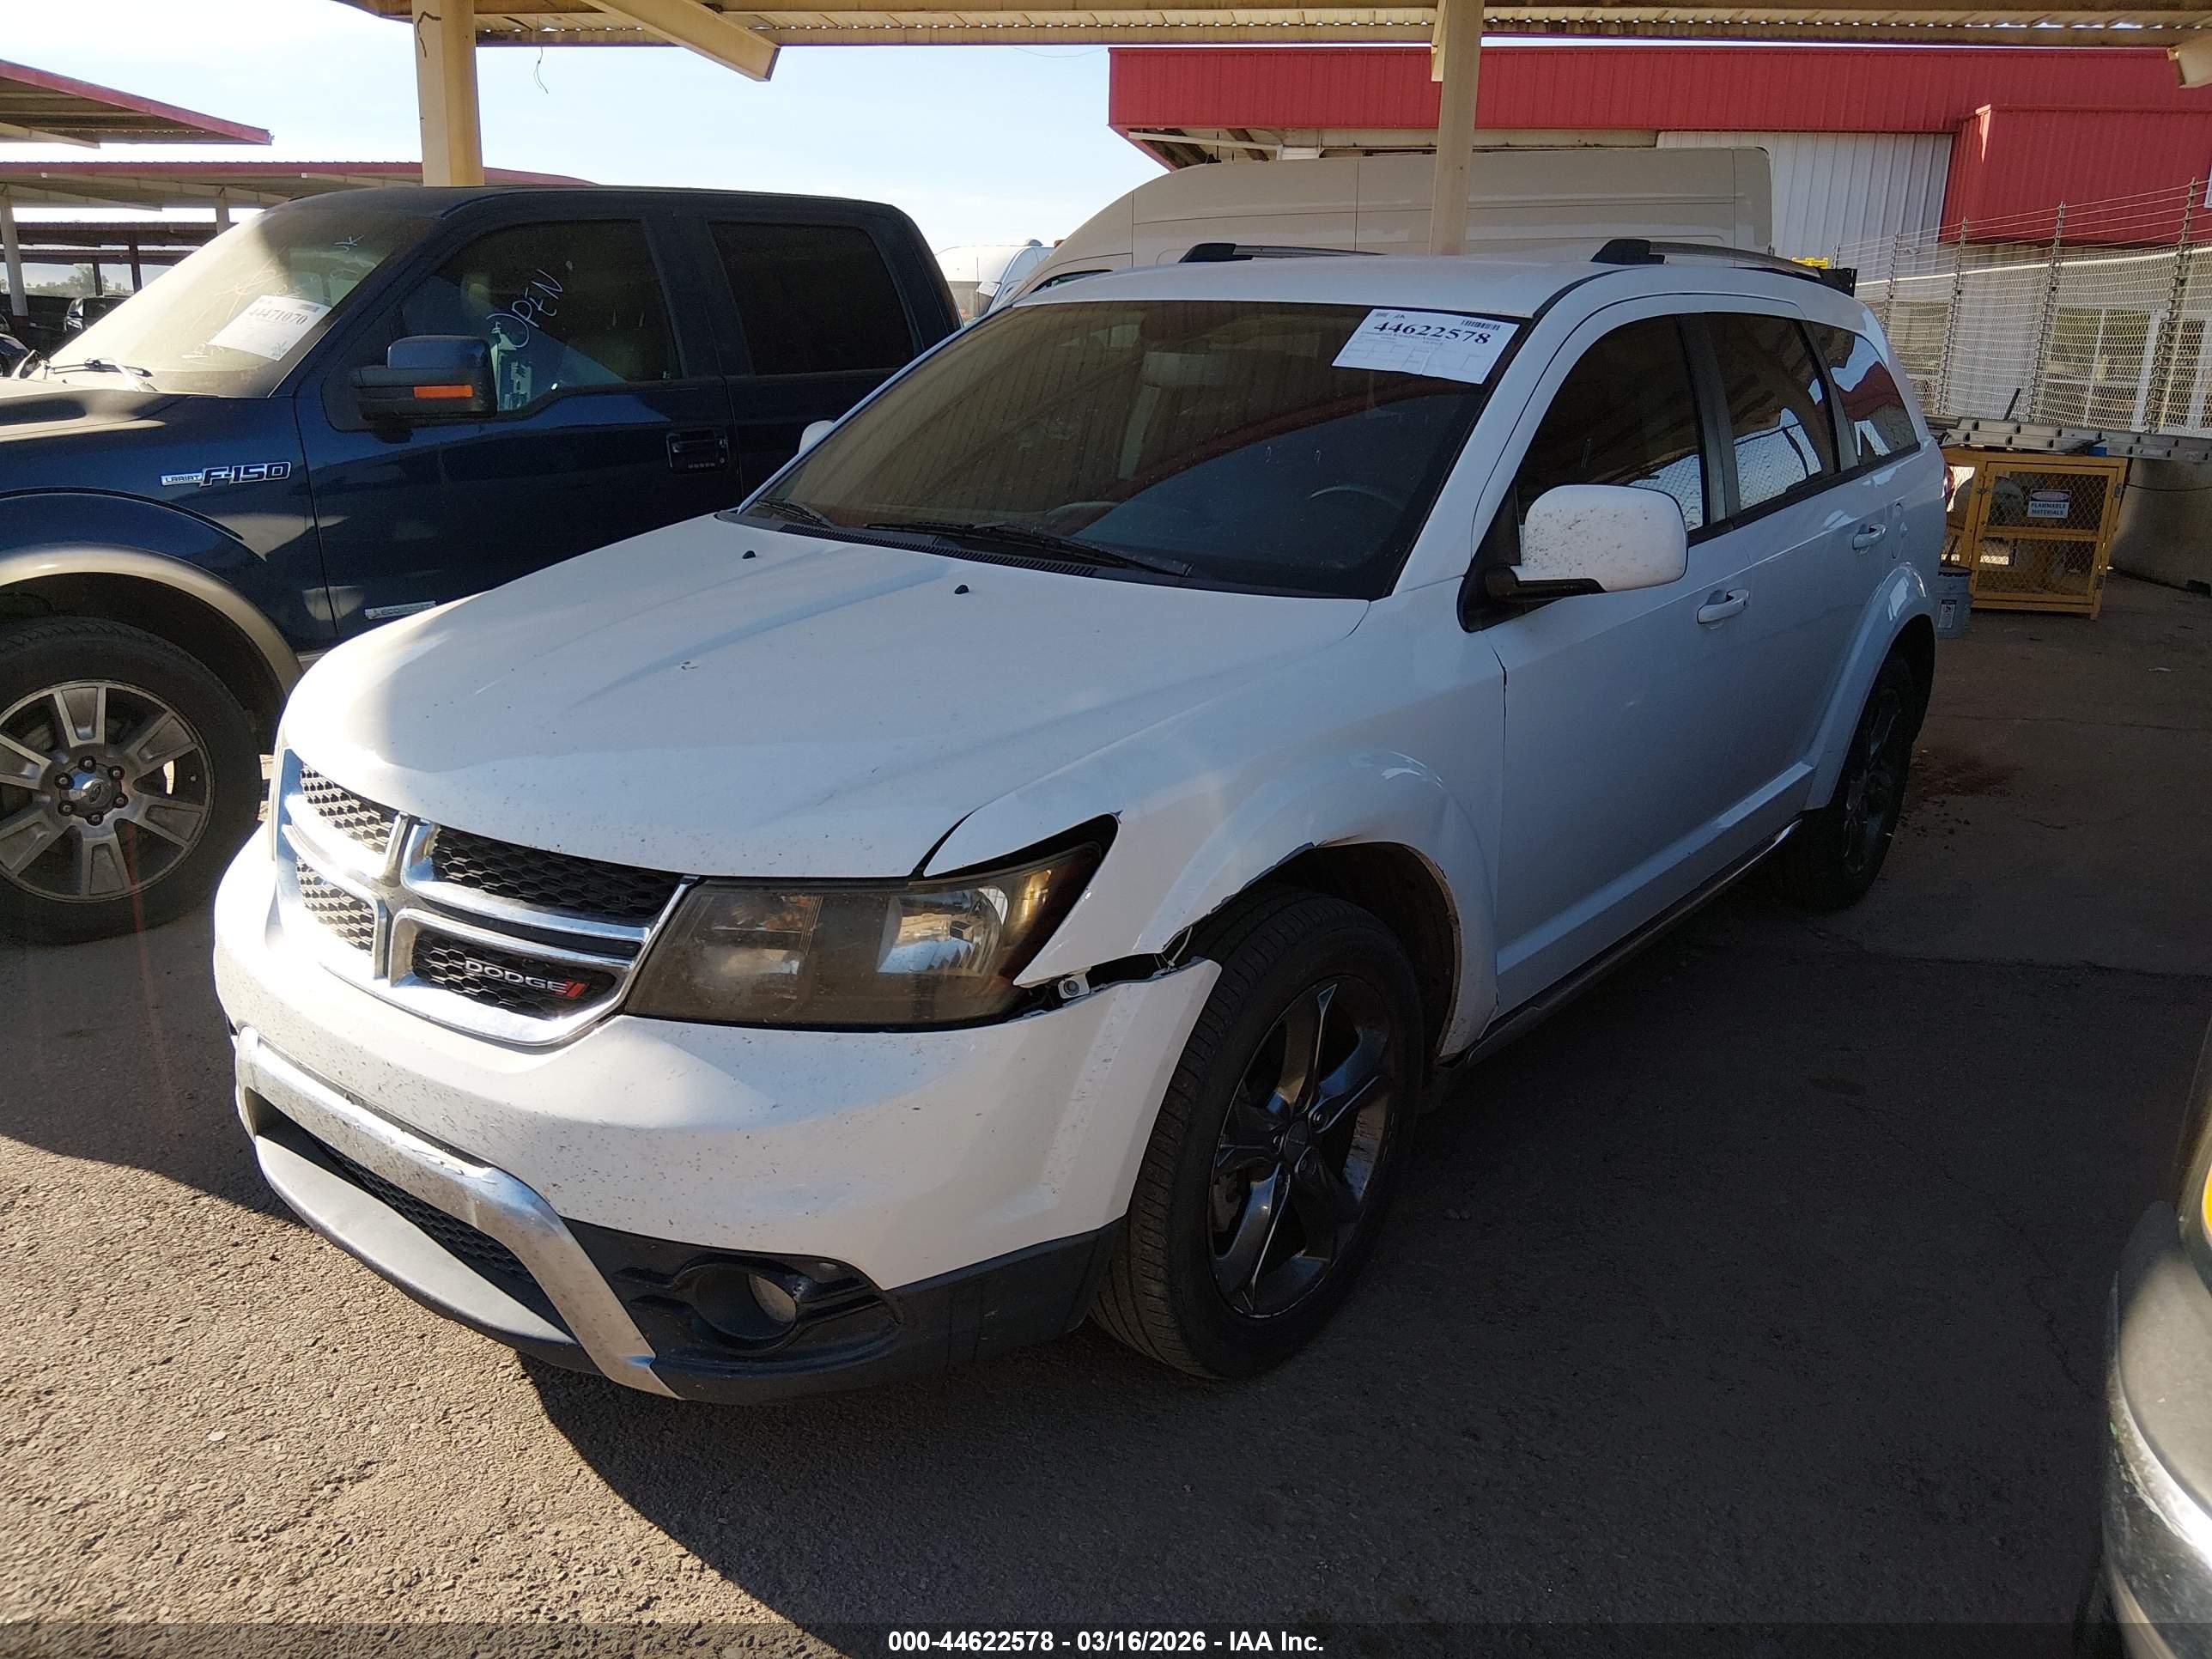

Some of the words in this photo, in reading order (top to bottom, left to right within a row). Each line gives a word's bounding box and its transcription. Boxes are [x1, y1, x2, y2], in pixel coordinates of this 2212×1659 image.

[1374, 321, 1492, 344] 44622578
[201, 461, 292, 487] F-150
[465, 959, 568, 994] DODGE
